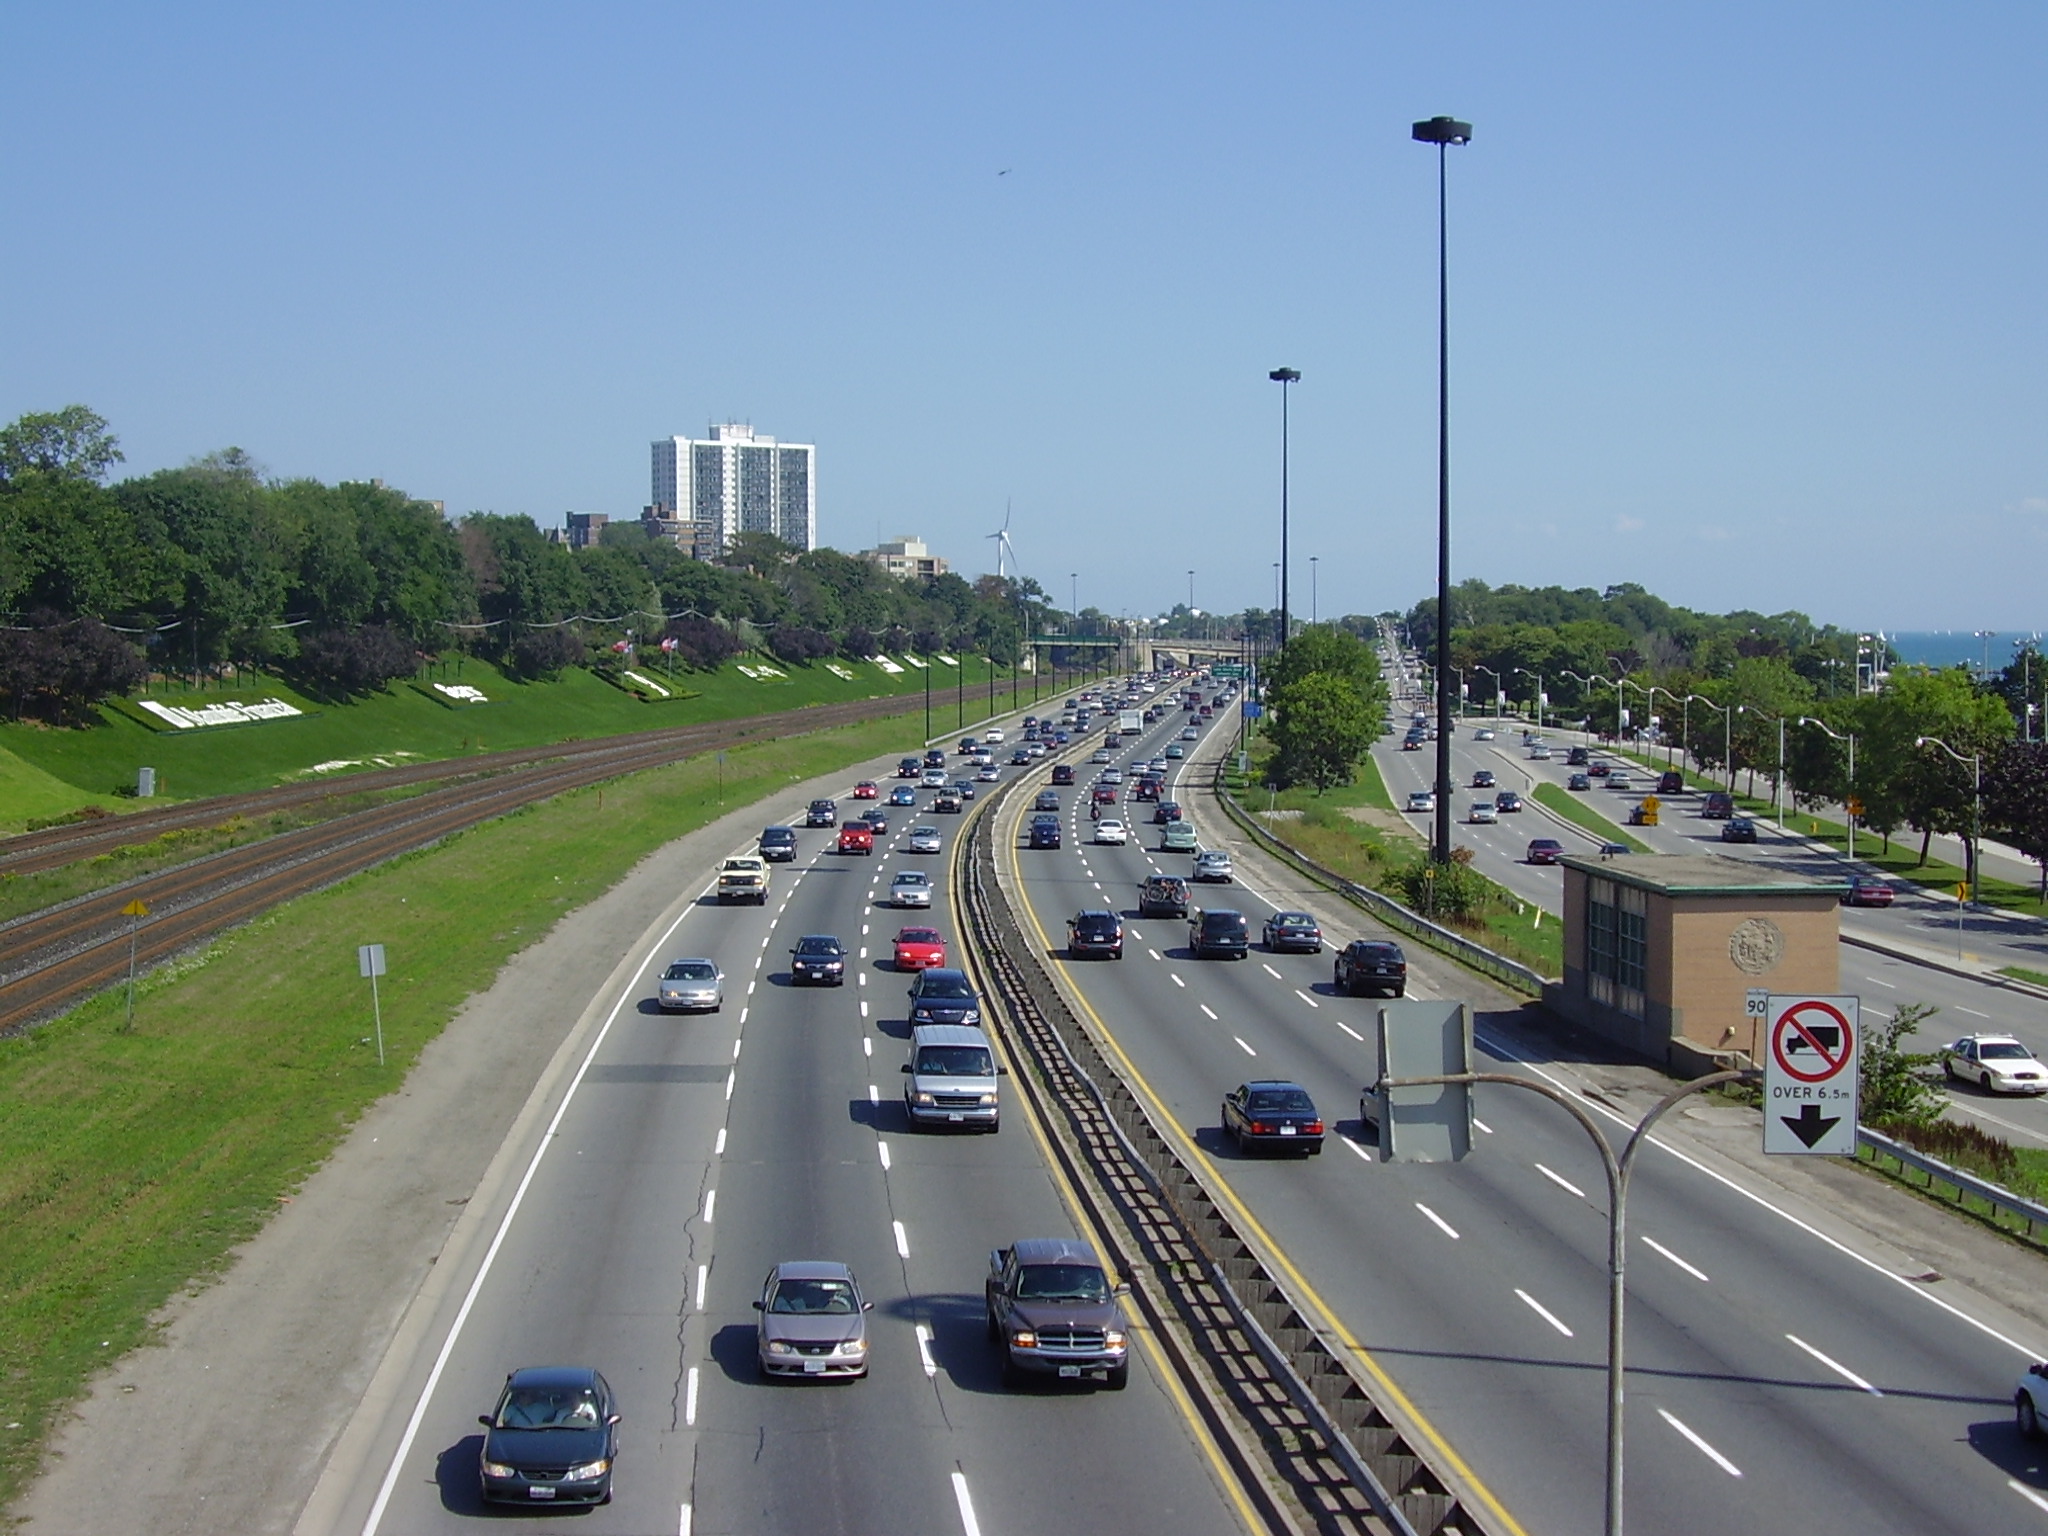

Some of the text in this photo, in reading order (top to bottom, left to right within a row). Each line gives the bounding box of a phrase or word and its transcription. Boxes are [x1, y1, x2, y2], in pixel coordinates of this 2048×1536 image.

[1747, 1000, 1766, 1013] 90
[1773, 1086, 1850, 1099] OVER 6.5m
